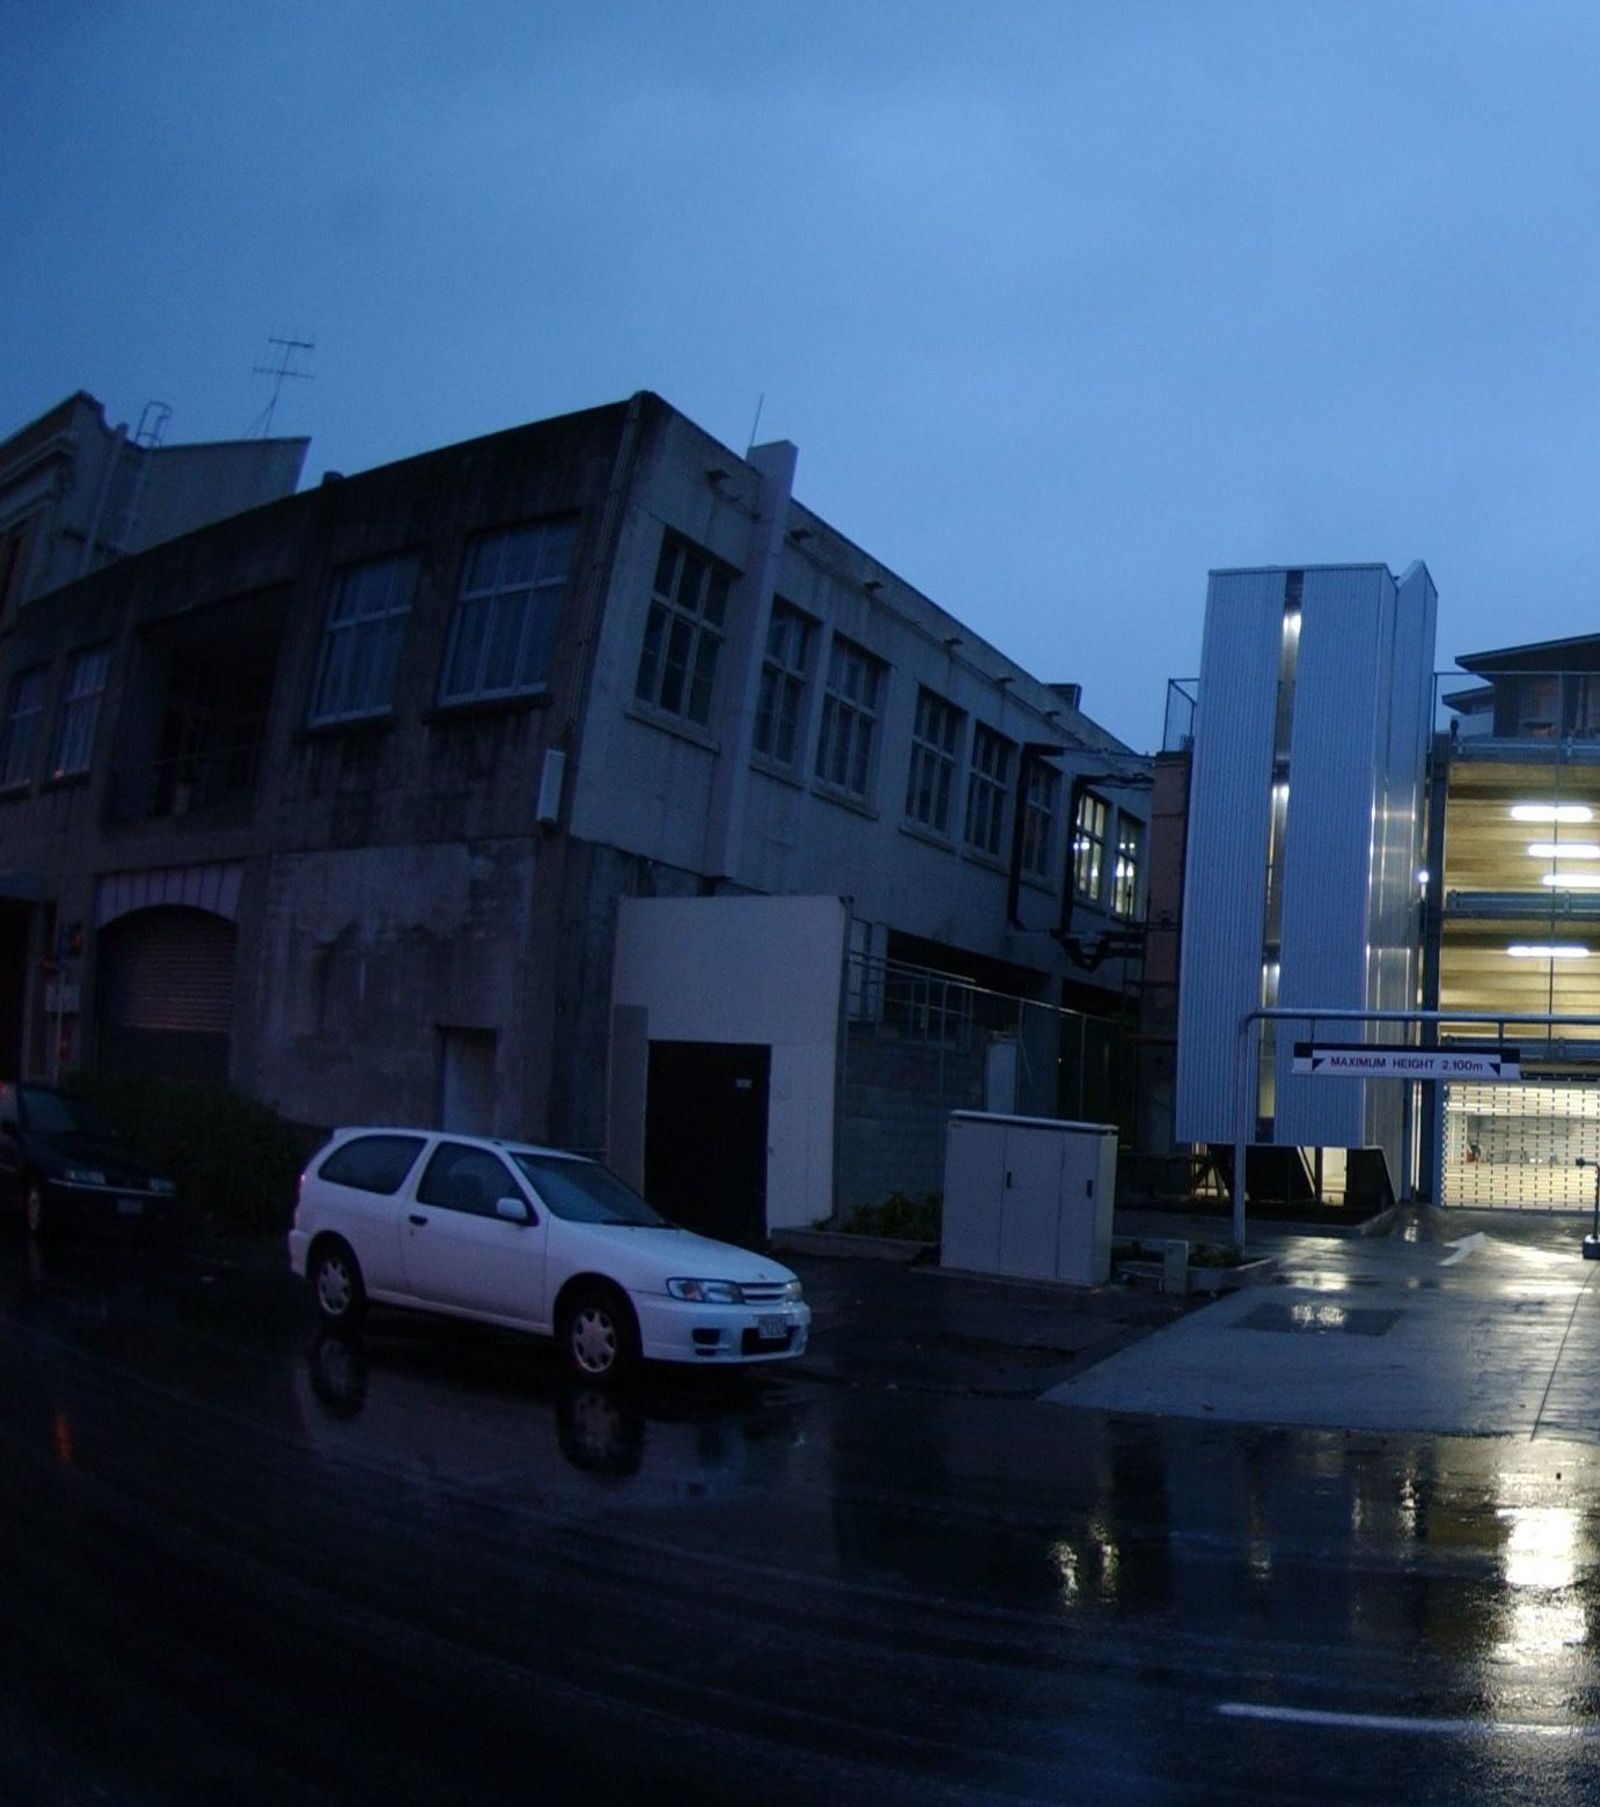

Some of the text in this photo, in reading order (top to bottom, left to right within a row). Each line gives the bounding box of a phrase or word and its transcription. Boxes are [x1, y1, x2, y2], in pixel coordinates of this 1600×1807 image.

[1330, 1056, 1483, 1072] MAXIMUM HEIGHT 2.100m
